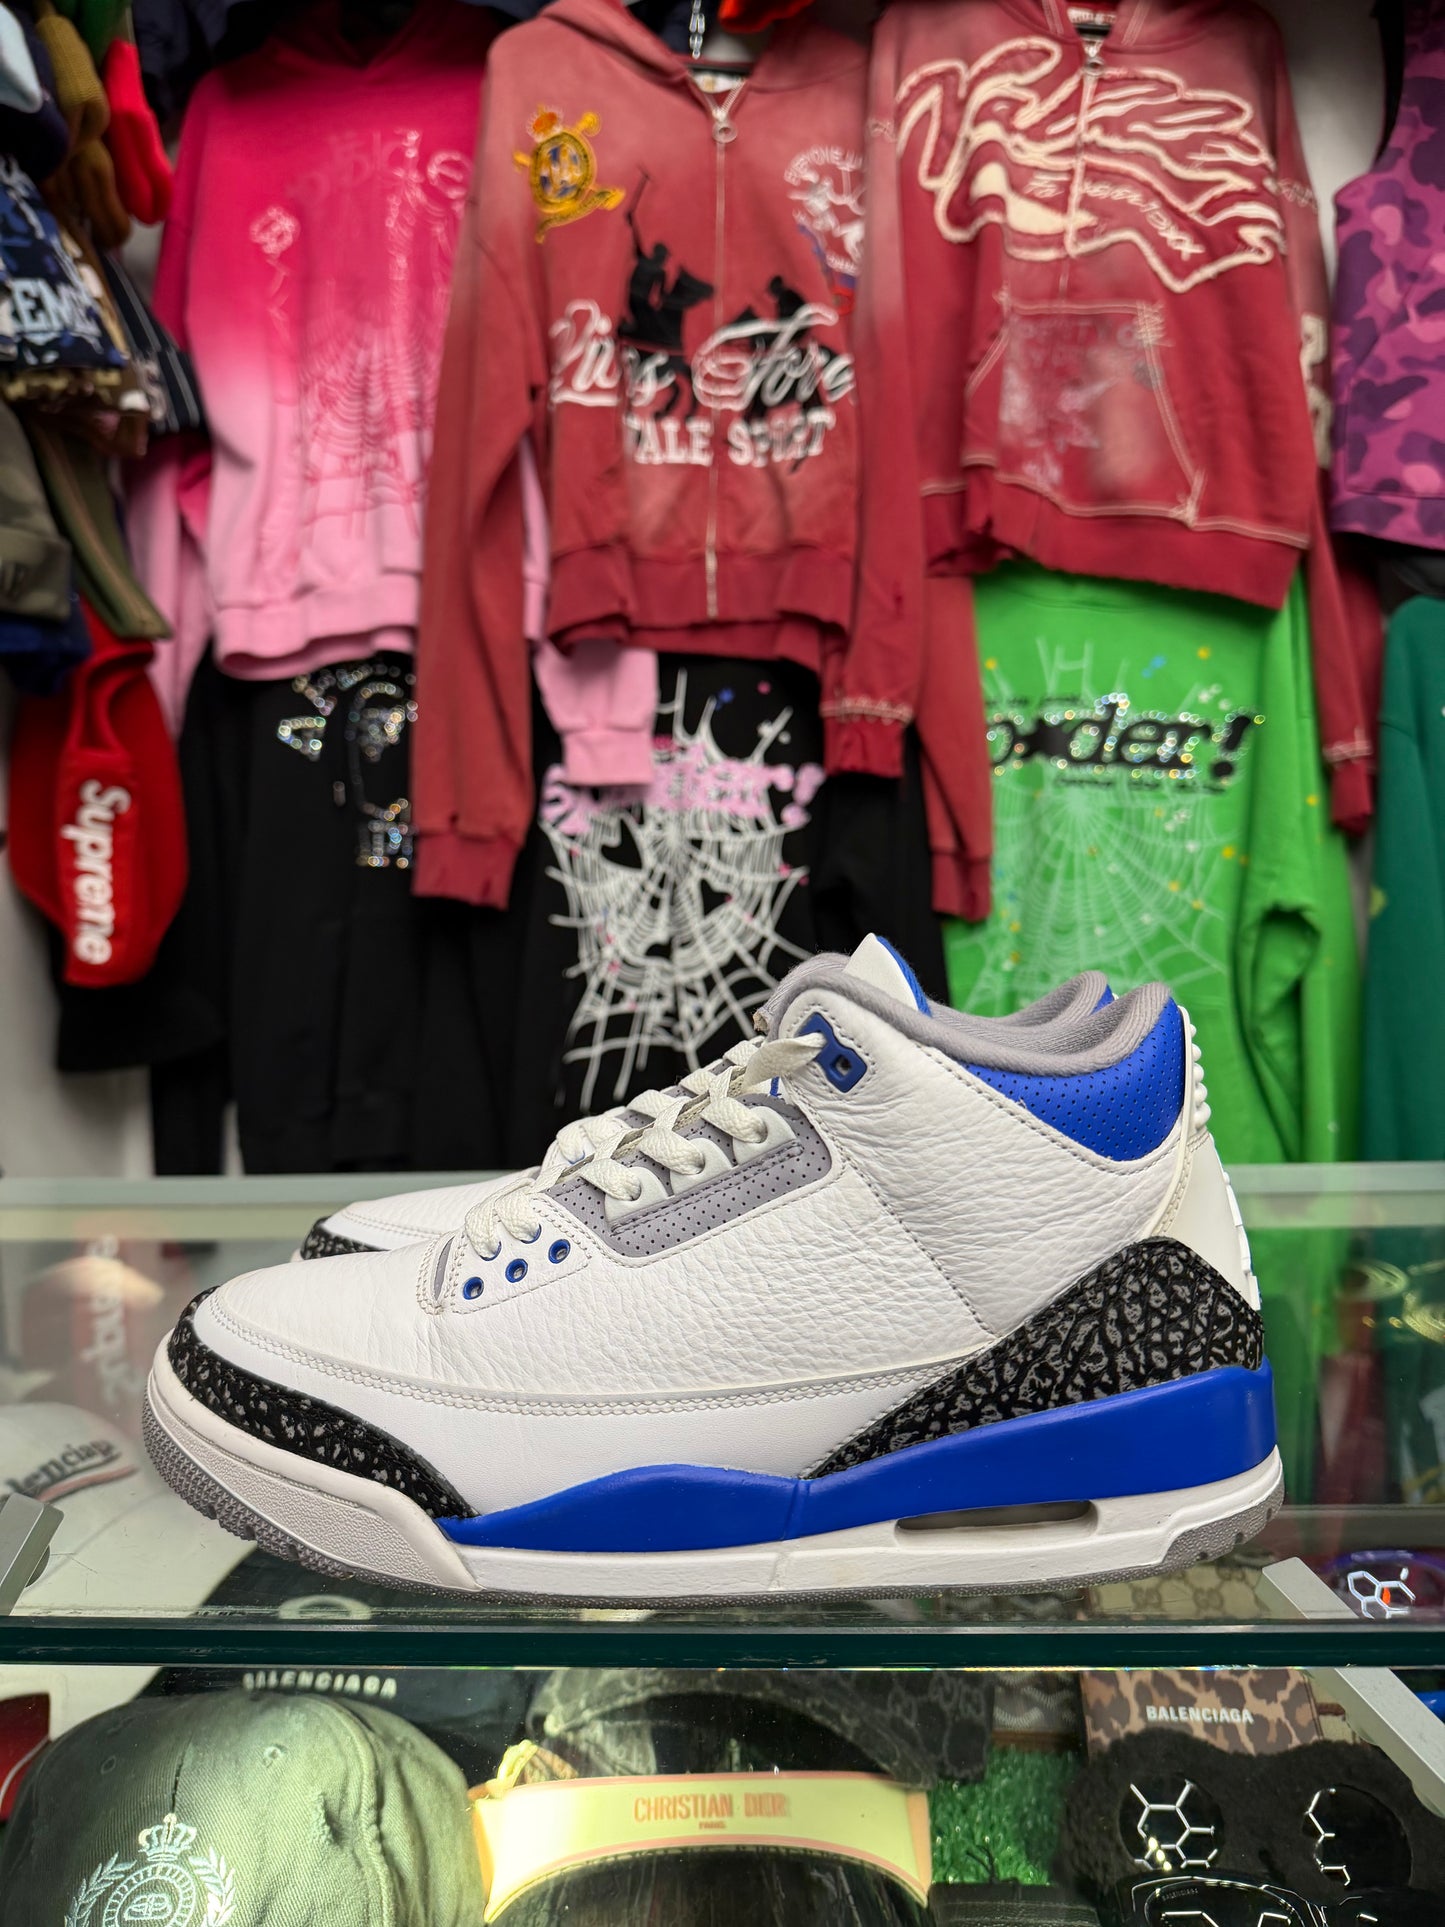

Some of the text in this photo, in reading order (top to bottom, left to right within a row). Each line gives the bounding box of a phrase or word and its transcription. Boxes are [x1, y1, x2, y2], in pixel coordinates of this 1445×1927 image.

[60, 778, 132, 965] Supreme
[1145, 1704, 1255, 1726] BALENCIAGA
[633, 1792, 735, 1824] CHRISTIAN
